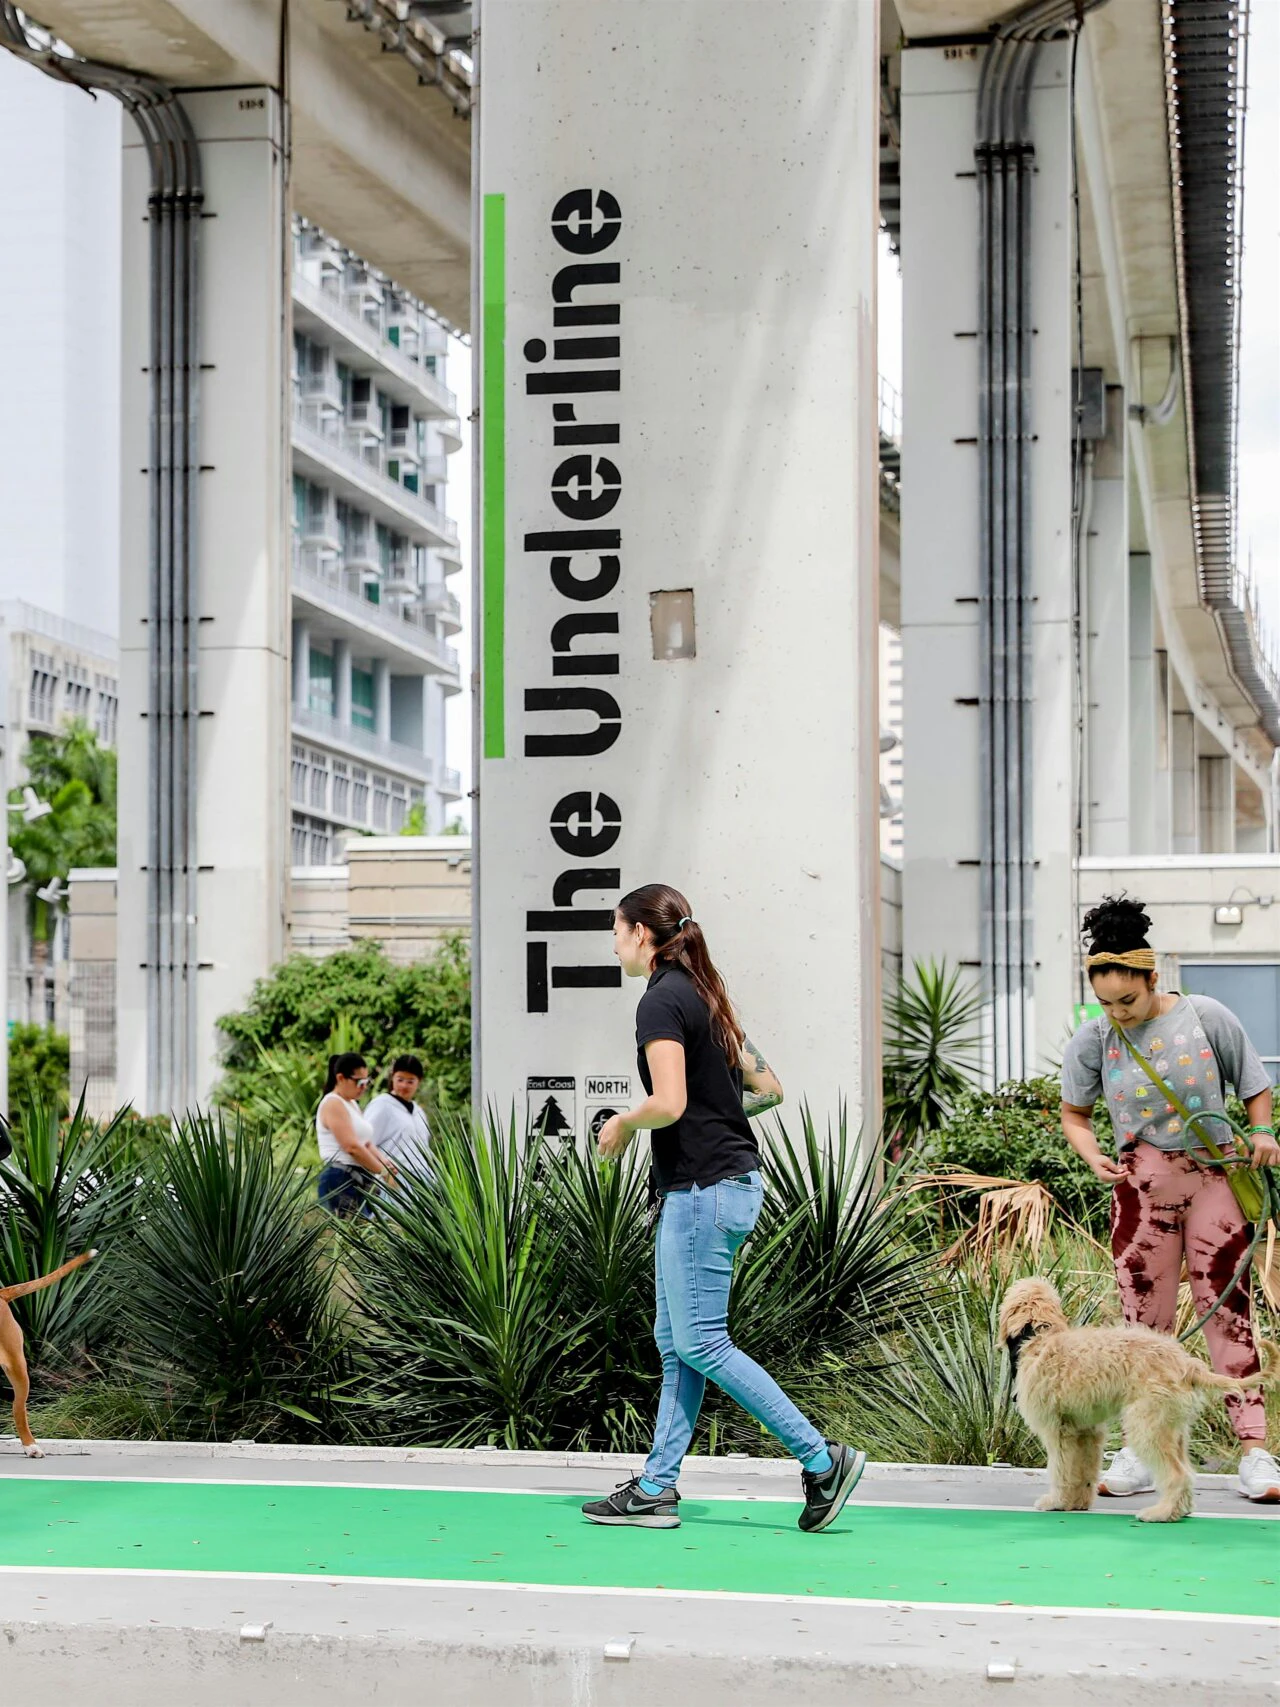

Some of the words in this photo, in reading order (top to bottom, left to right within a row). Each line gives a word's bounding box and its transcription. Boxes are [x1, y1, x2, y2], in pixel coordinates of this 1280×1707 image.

[523, 188, 622, 757] Underline
[526, 791, 622, 1013] The
[547, 1079, 575, 1089] Coast
[588, 1080, 628, 1093] NORTH
